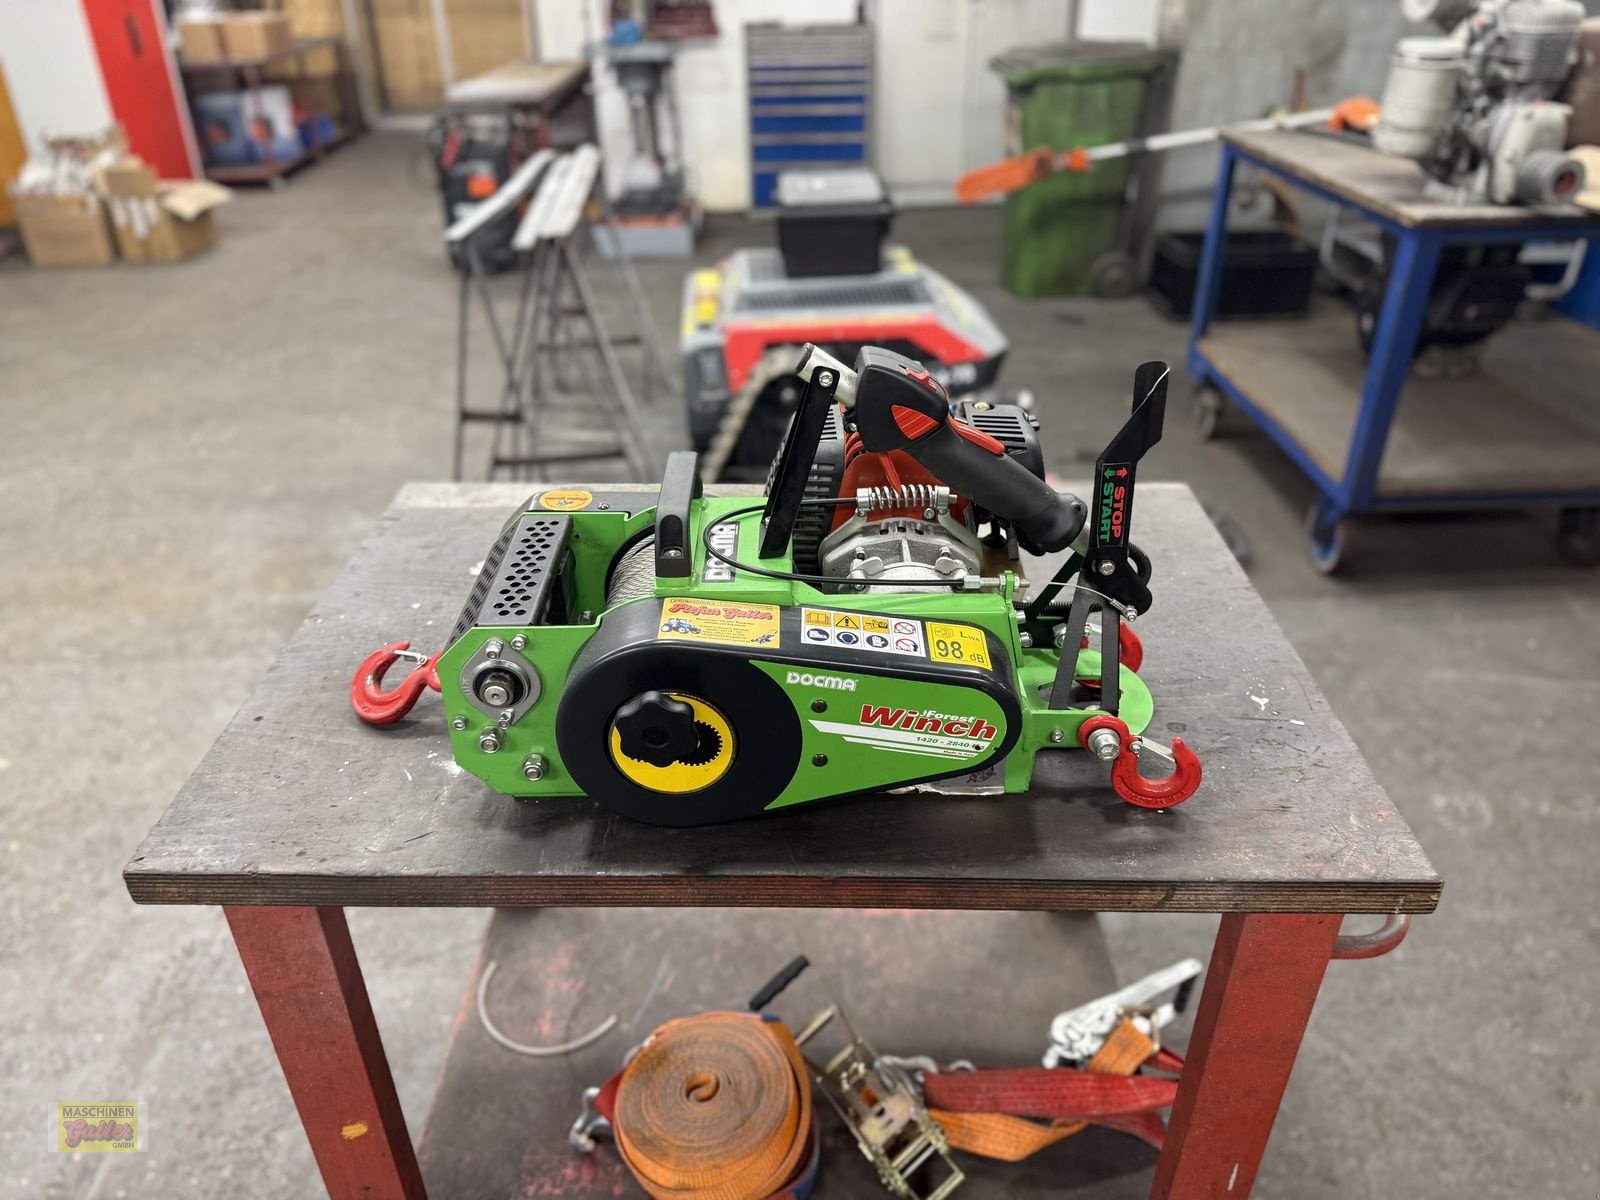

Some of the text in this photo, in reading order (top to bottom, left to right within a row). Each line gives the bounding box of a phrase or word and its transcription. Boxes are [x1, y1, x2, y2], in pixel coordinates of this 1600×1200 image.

[1100, 482, 1115, 543] START
[1111, 486, 1125, 537] STOP
[936, 639, 985, 664] 98 dB
[786, 671, 856, 692] DOCMA
[859, 704, 997, 740] Winch
[916, 736, 939, 744] 1420
